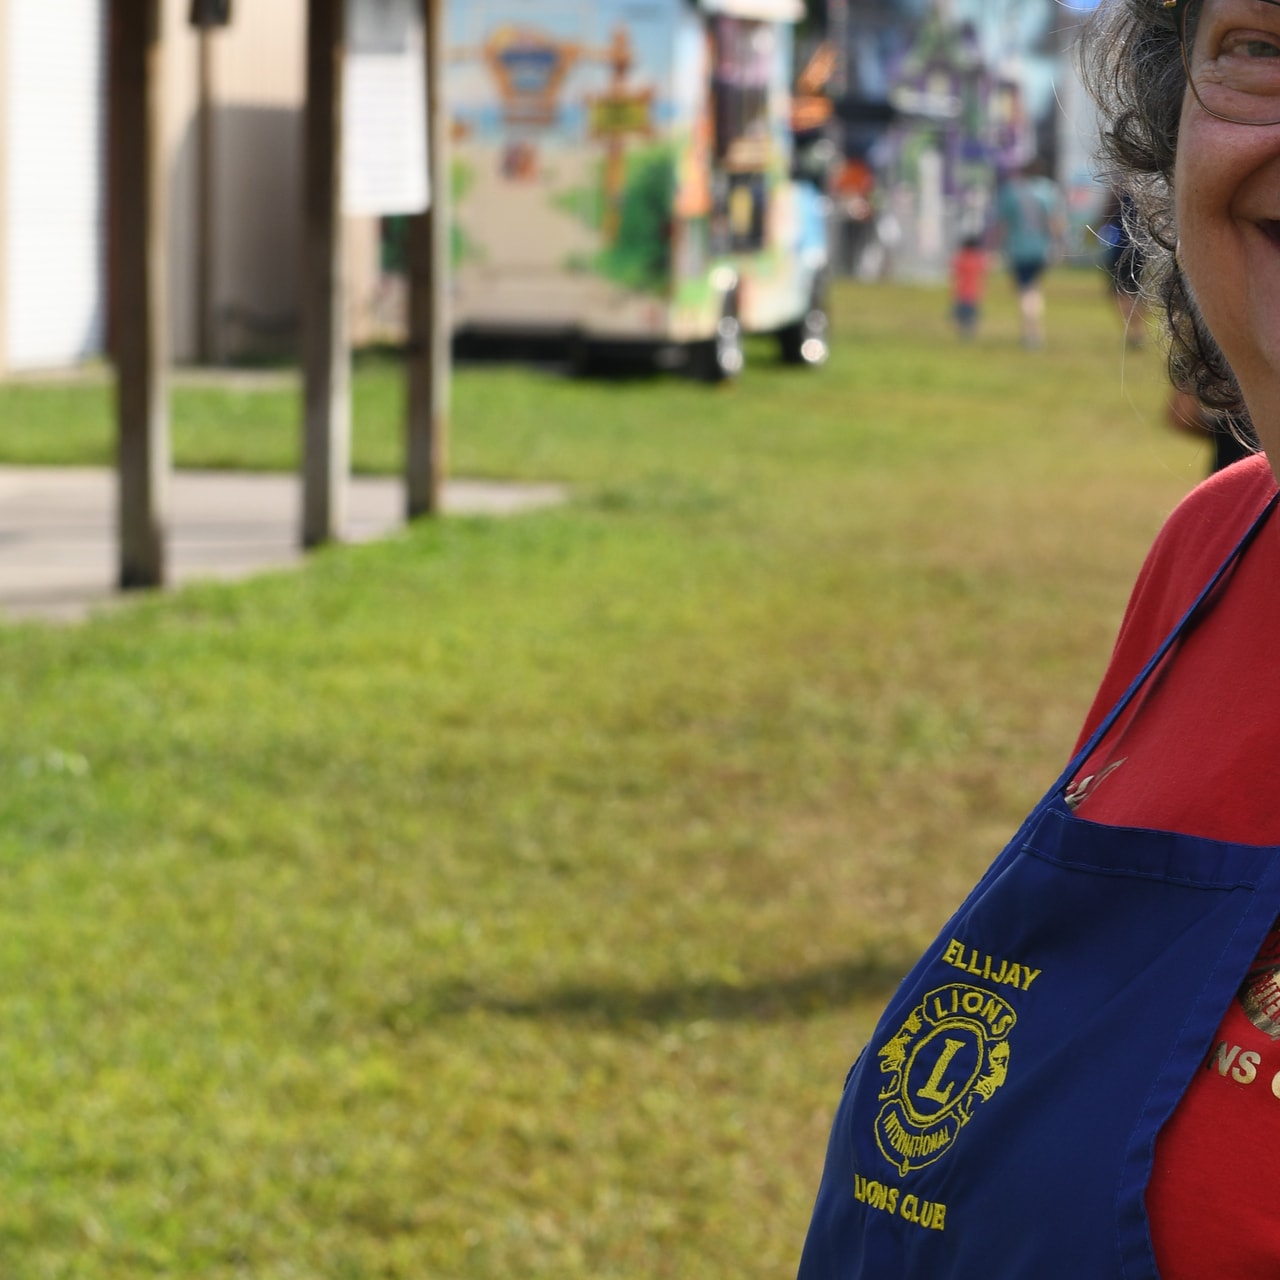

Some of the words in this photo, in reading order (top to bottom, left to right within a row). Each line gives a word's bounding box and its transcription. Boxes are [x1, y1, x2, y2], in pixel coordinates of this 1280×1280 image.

[942, 938, 1042, 991] ELLIJAY
[934, 989, 1013, 1035] LIONS
[916, 1038, 966, 1104] L
[882, 1109, 951, 1158] INTERNATIONAL
[854, 1173, 899, 1215] LIONS
[900, 1194, 947, 1231] CLUB
